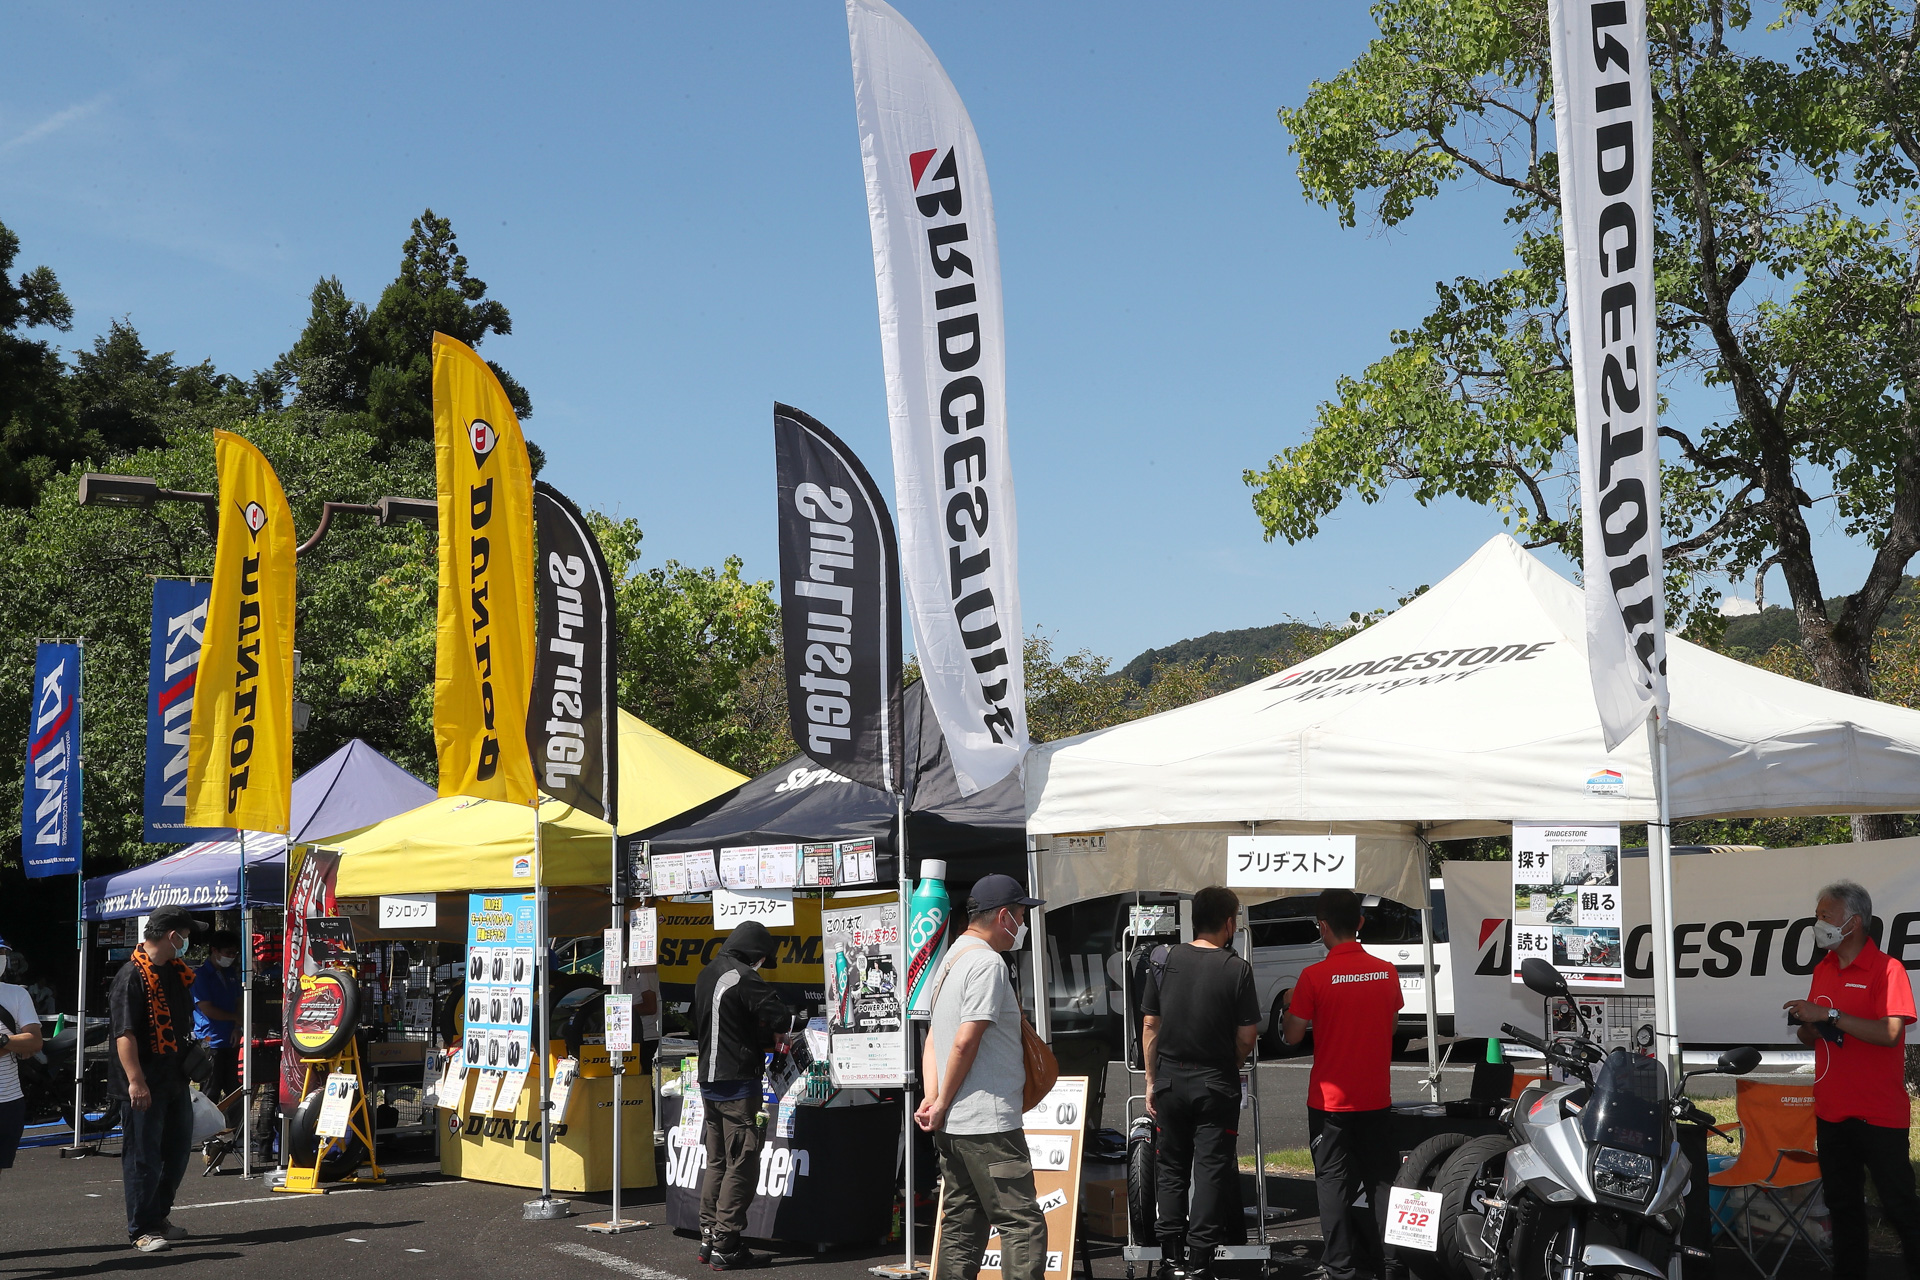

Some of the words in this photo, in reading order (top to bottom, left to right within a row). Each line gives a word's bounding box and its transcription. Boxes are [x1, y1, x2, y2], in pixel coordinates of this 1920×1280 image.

[1263, 641, 1556, 691] BRIDGESTONE
[1238, 853, 1344, 873] ブリヂストン
[1518, 851, 1550, 869] 探す
[720, 900, 787, 916] シュアラスター
[1581, 892, 1615, 911] 観る
[386, 904, 428, 918] ダンロップ
[826, 915, 862, 933] この1本で
[853, 926, 898, 946] 走りが変わる
[1517, 933, 1548, 951] 読む
[658, 935, 824, 966] SPOTM
[1331, 971, 1389, 984] BRIDGESTONE
[666, 1126, 810, 1197] Surter
[1398, 1211, 1429, 1227] T32
